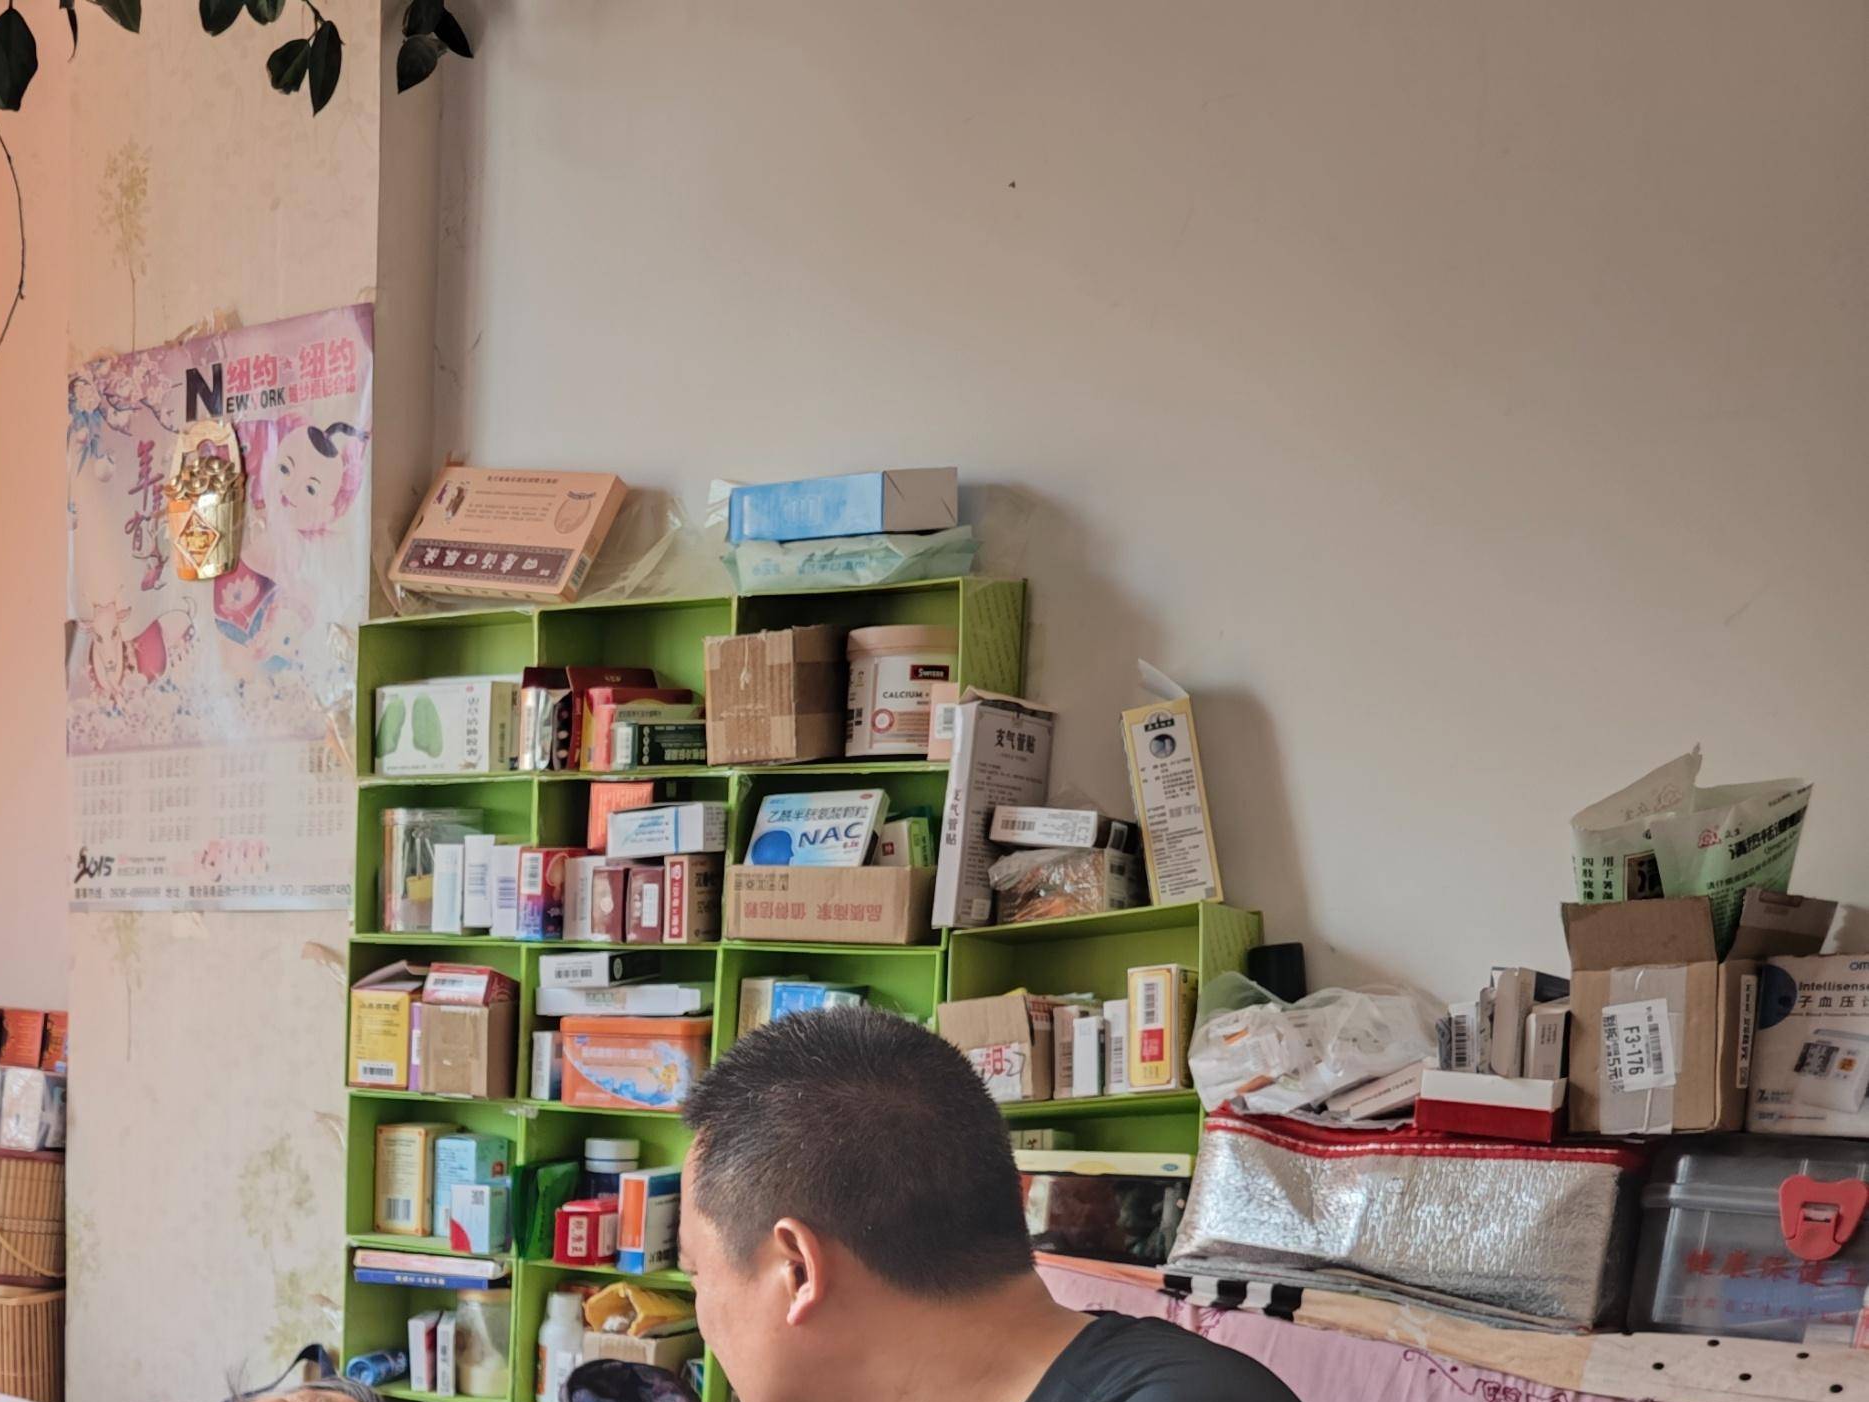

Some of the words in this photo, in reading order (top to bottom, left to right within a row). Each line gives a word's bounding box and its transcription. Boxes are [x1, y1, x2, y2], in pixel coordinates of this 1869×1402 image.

[226, 353, 279, 393] 纽约
[299, 338, 356, 378] 纽约
[917, 667, 945, 678] Swisse
[882, 691, 923, 699] CALCIUM
[994, 728, 1037, 754] 支气管贴
[945, 788, 963, 846] 支气管贴
[798, 822, 864, 848] NAC
[817, 902, 883, 922] 品质商家
[1623, 1025, 1646, 1076] F3-176
